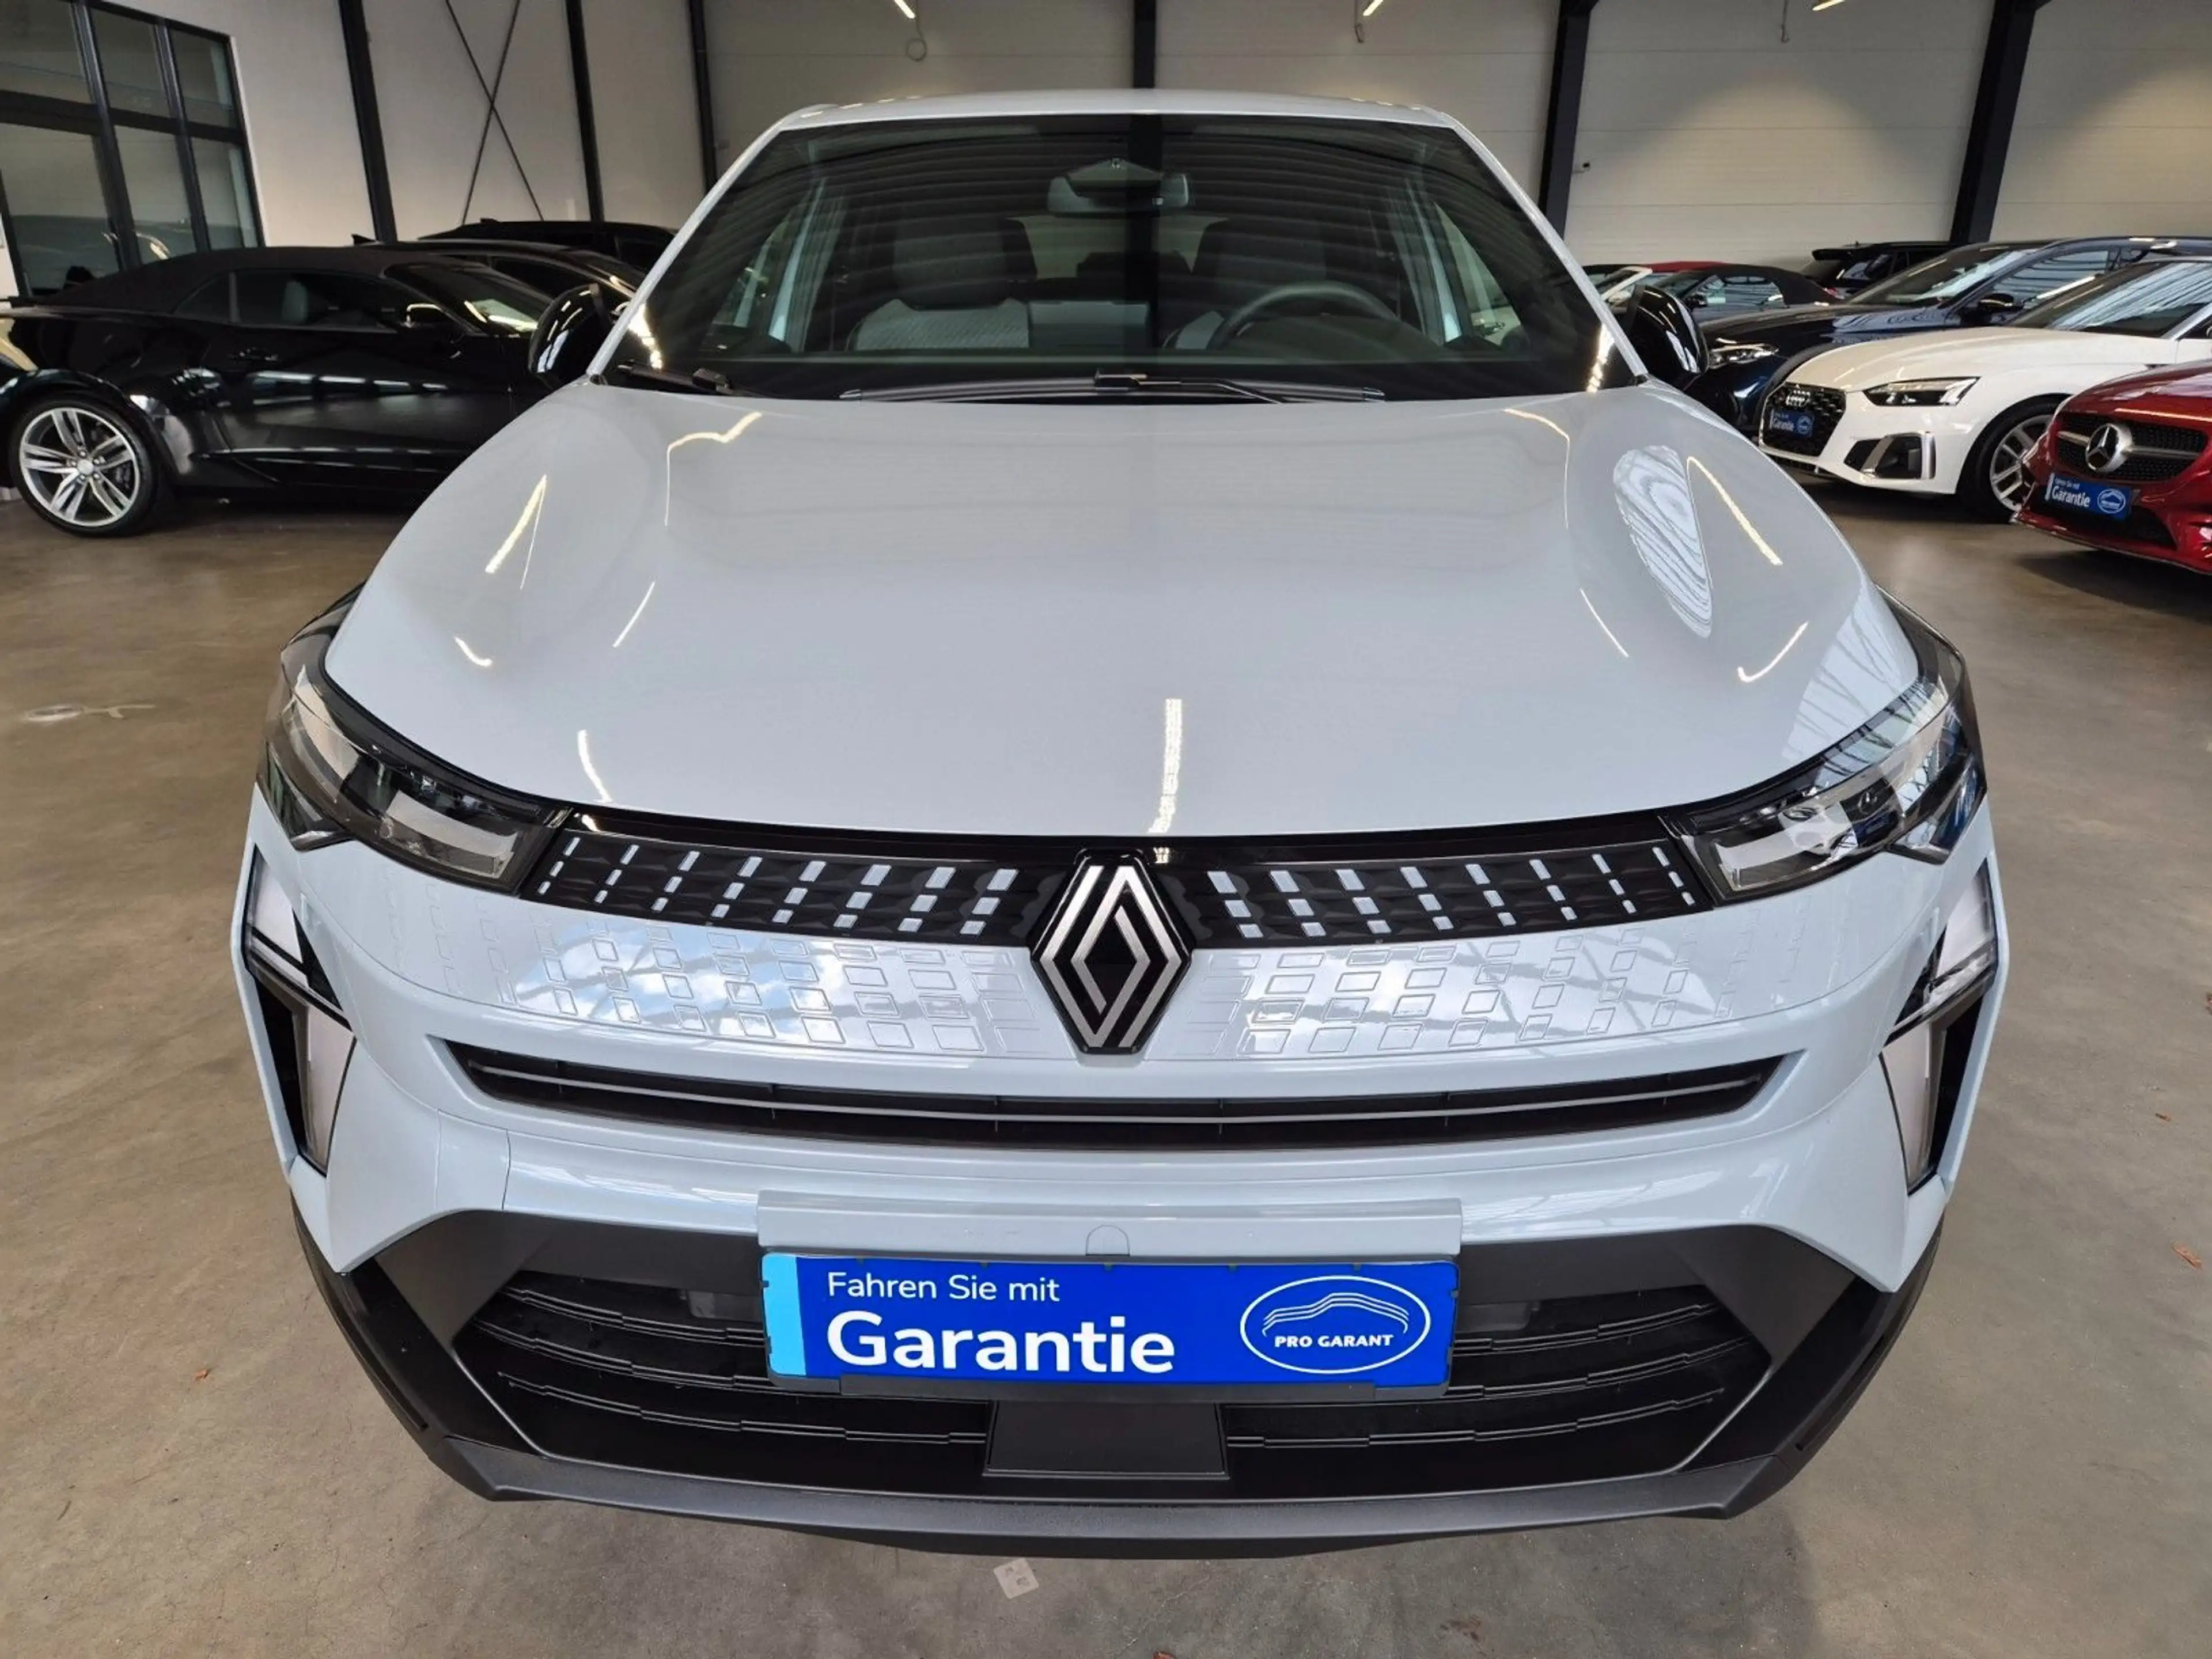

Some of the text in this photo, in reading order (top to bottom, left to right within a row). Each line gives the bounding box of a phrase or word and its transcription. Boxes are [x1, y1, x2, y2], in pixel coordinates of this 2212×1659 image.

[2051, 485, 2090, 507] Garantie
[828, 1272, 1060, 1302] Fahren Sie mit
[827, 1310, 1175, 1374] Garantie
[1274, 1334, 1394, 1349] PRO GARANT
